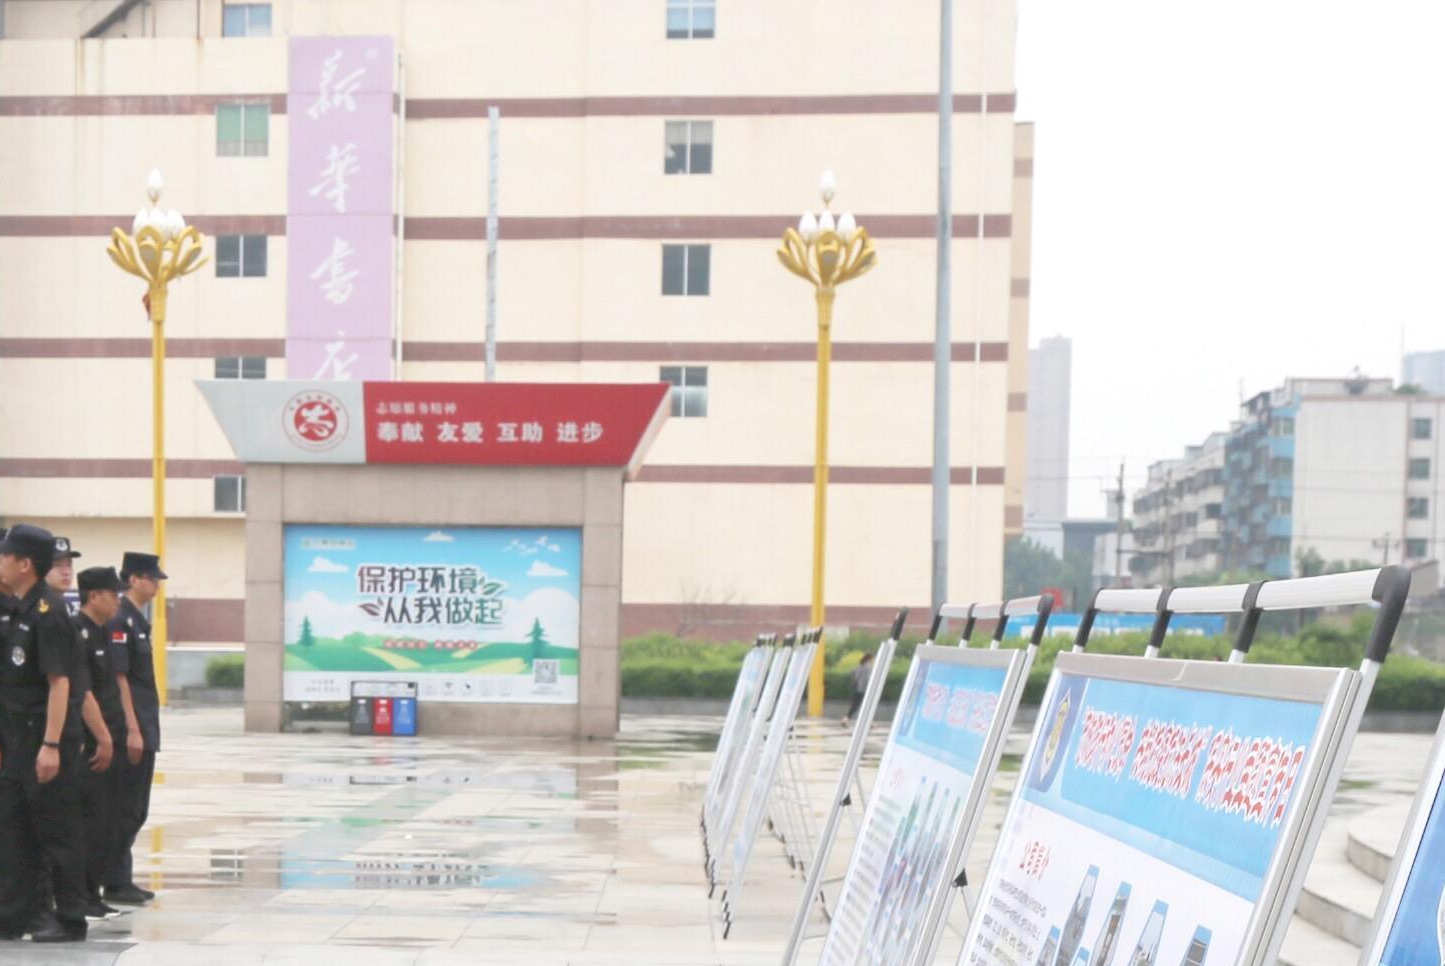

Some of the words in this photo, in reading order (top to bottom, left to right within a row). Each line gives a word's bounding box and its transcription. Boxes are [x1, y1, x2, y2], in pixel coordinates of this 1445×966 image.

[377, 421, 424, 443] 奉献
[437, 421, 484, 443] 友爱
[497, 422, 543, 444] 互助
[556, 422, 604, 444] 进步
[358, 566, 479, 595] 保护环境
[383, 596, 504, 625] 从我做起
